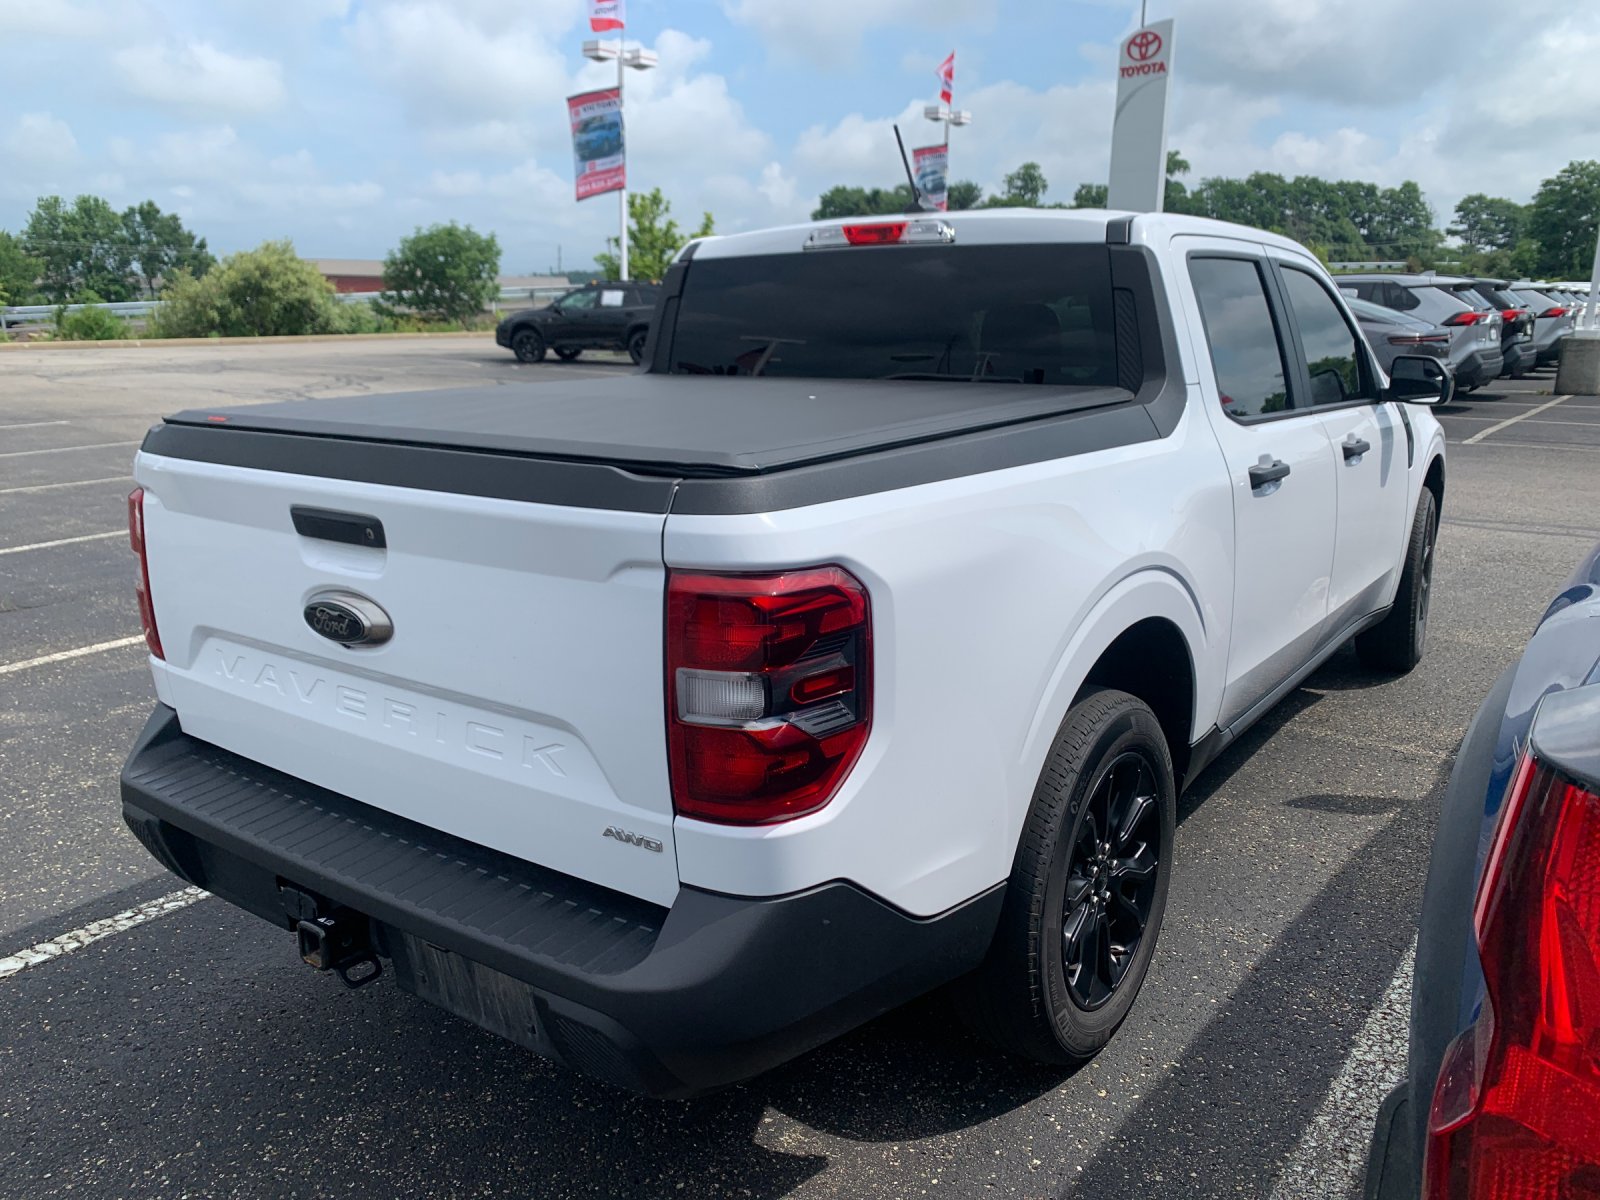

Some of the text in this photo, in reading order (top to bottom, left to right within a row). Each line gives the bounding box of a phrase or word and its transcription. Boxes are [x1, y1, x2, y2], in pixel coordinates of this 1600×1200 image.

[1120, 62, 1166, 78] TOYOTA
[312, 607, 353, 636] Ford
[214, 648, 567, 778] MAVERICK
[602, 825, 664, 853] AWD
